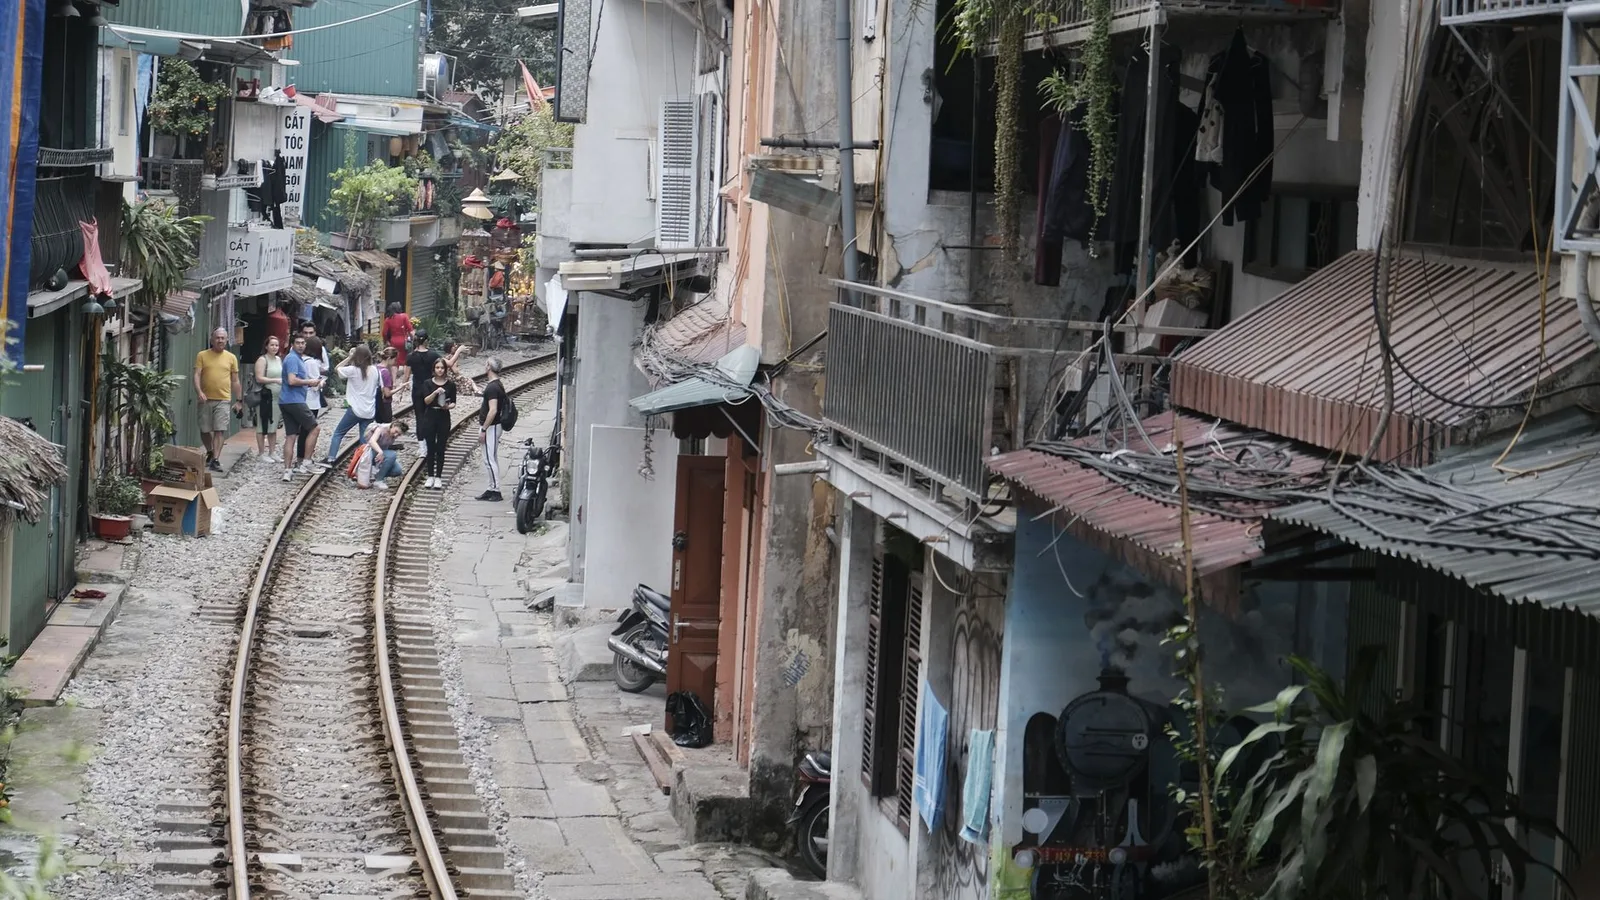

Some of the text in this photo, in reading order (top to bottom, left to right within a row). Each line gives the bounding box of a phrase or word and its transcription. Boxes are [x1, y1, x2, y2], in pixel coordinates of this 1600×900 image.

[285, 110, 304, 129] CẮT
[284, 133, 303, 149] TÓC
[282, 156, 303, 169] NAM
[229, 256, 248, 269] TÓC
